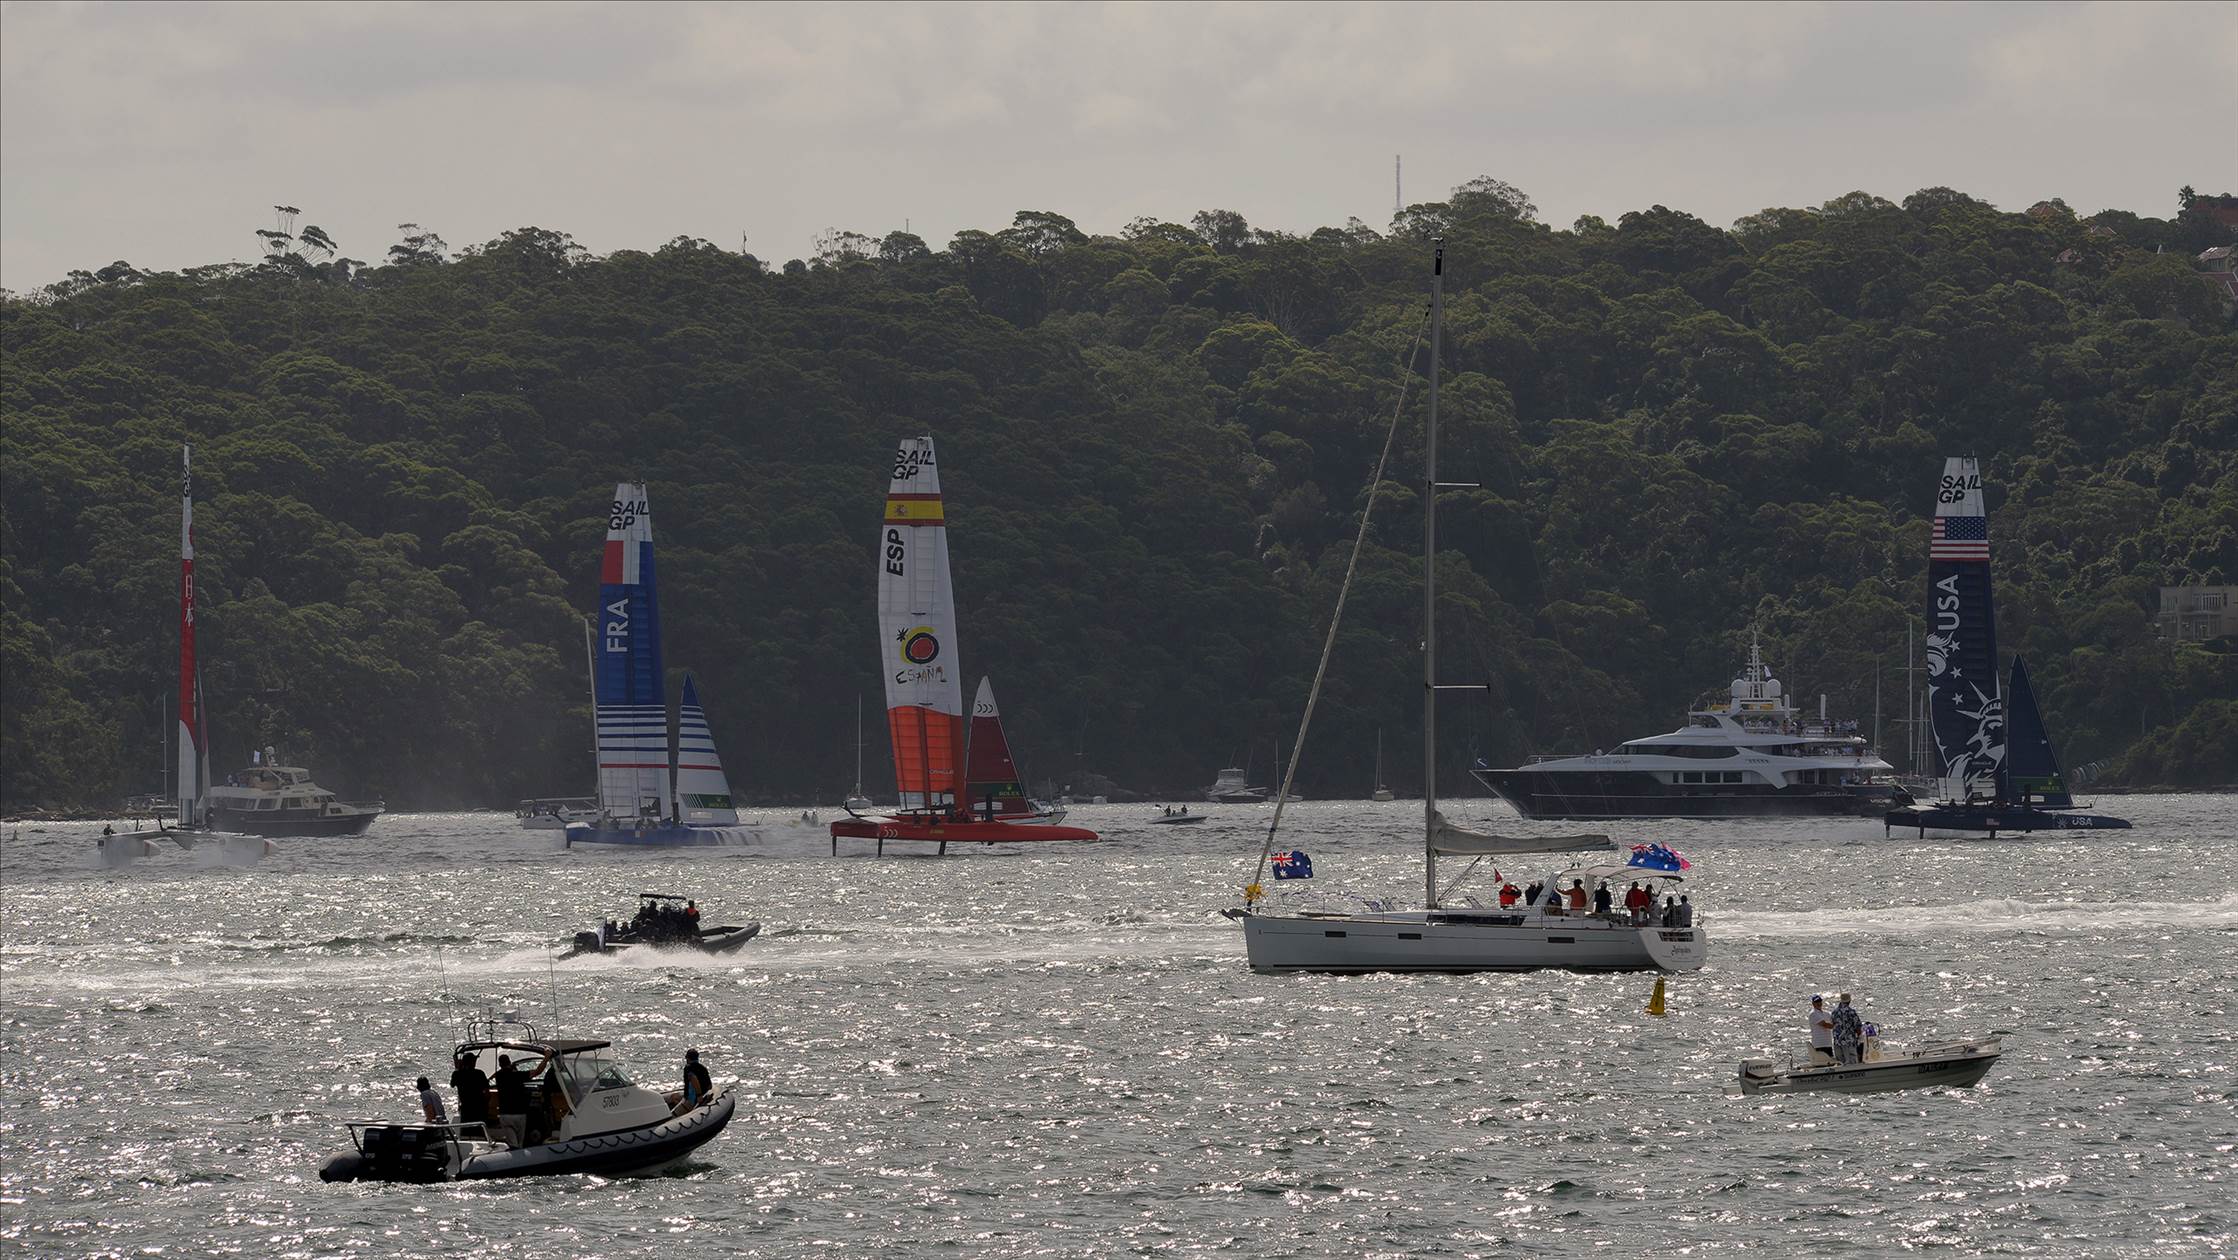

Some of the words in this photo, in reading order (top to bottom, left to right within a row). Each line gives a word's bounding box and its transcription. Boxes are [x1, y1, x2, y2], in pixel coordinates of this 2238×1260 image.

[895, 449, 935, 465] SAIL
[892, 465, 919, 480] GP
[1941, 475, 1982, 490] SAIL
[1938, 490, 1965, 504] GP
[611, 501, 649, 515] SAIL
[609, 516, 635, 531] GP
[886, 528, 905, 577] ESP
[1936, 574, 1960, 631] USA
[606, 598, 629, 653] FRA
[2072, 816, 2093, 827] USA
